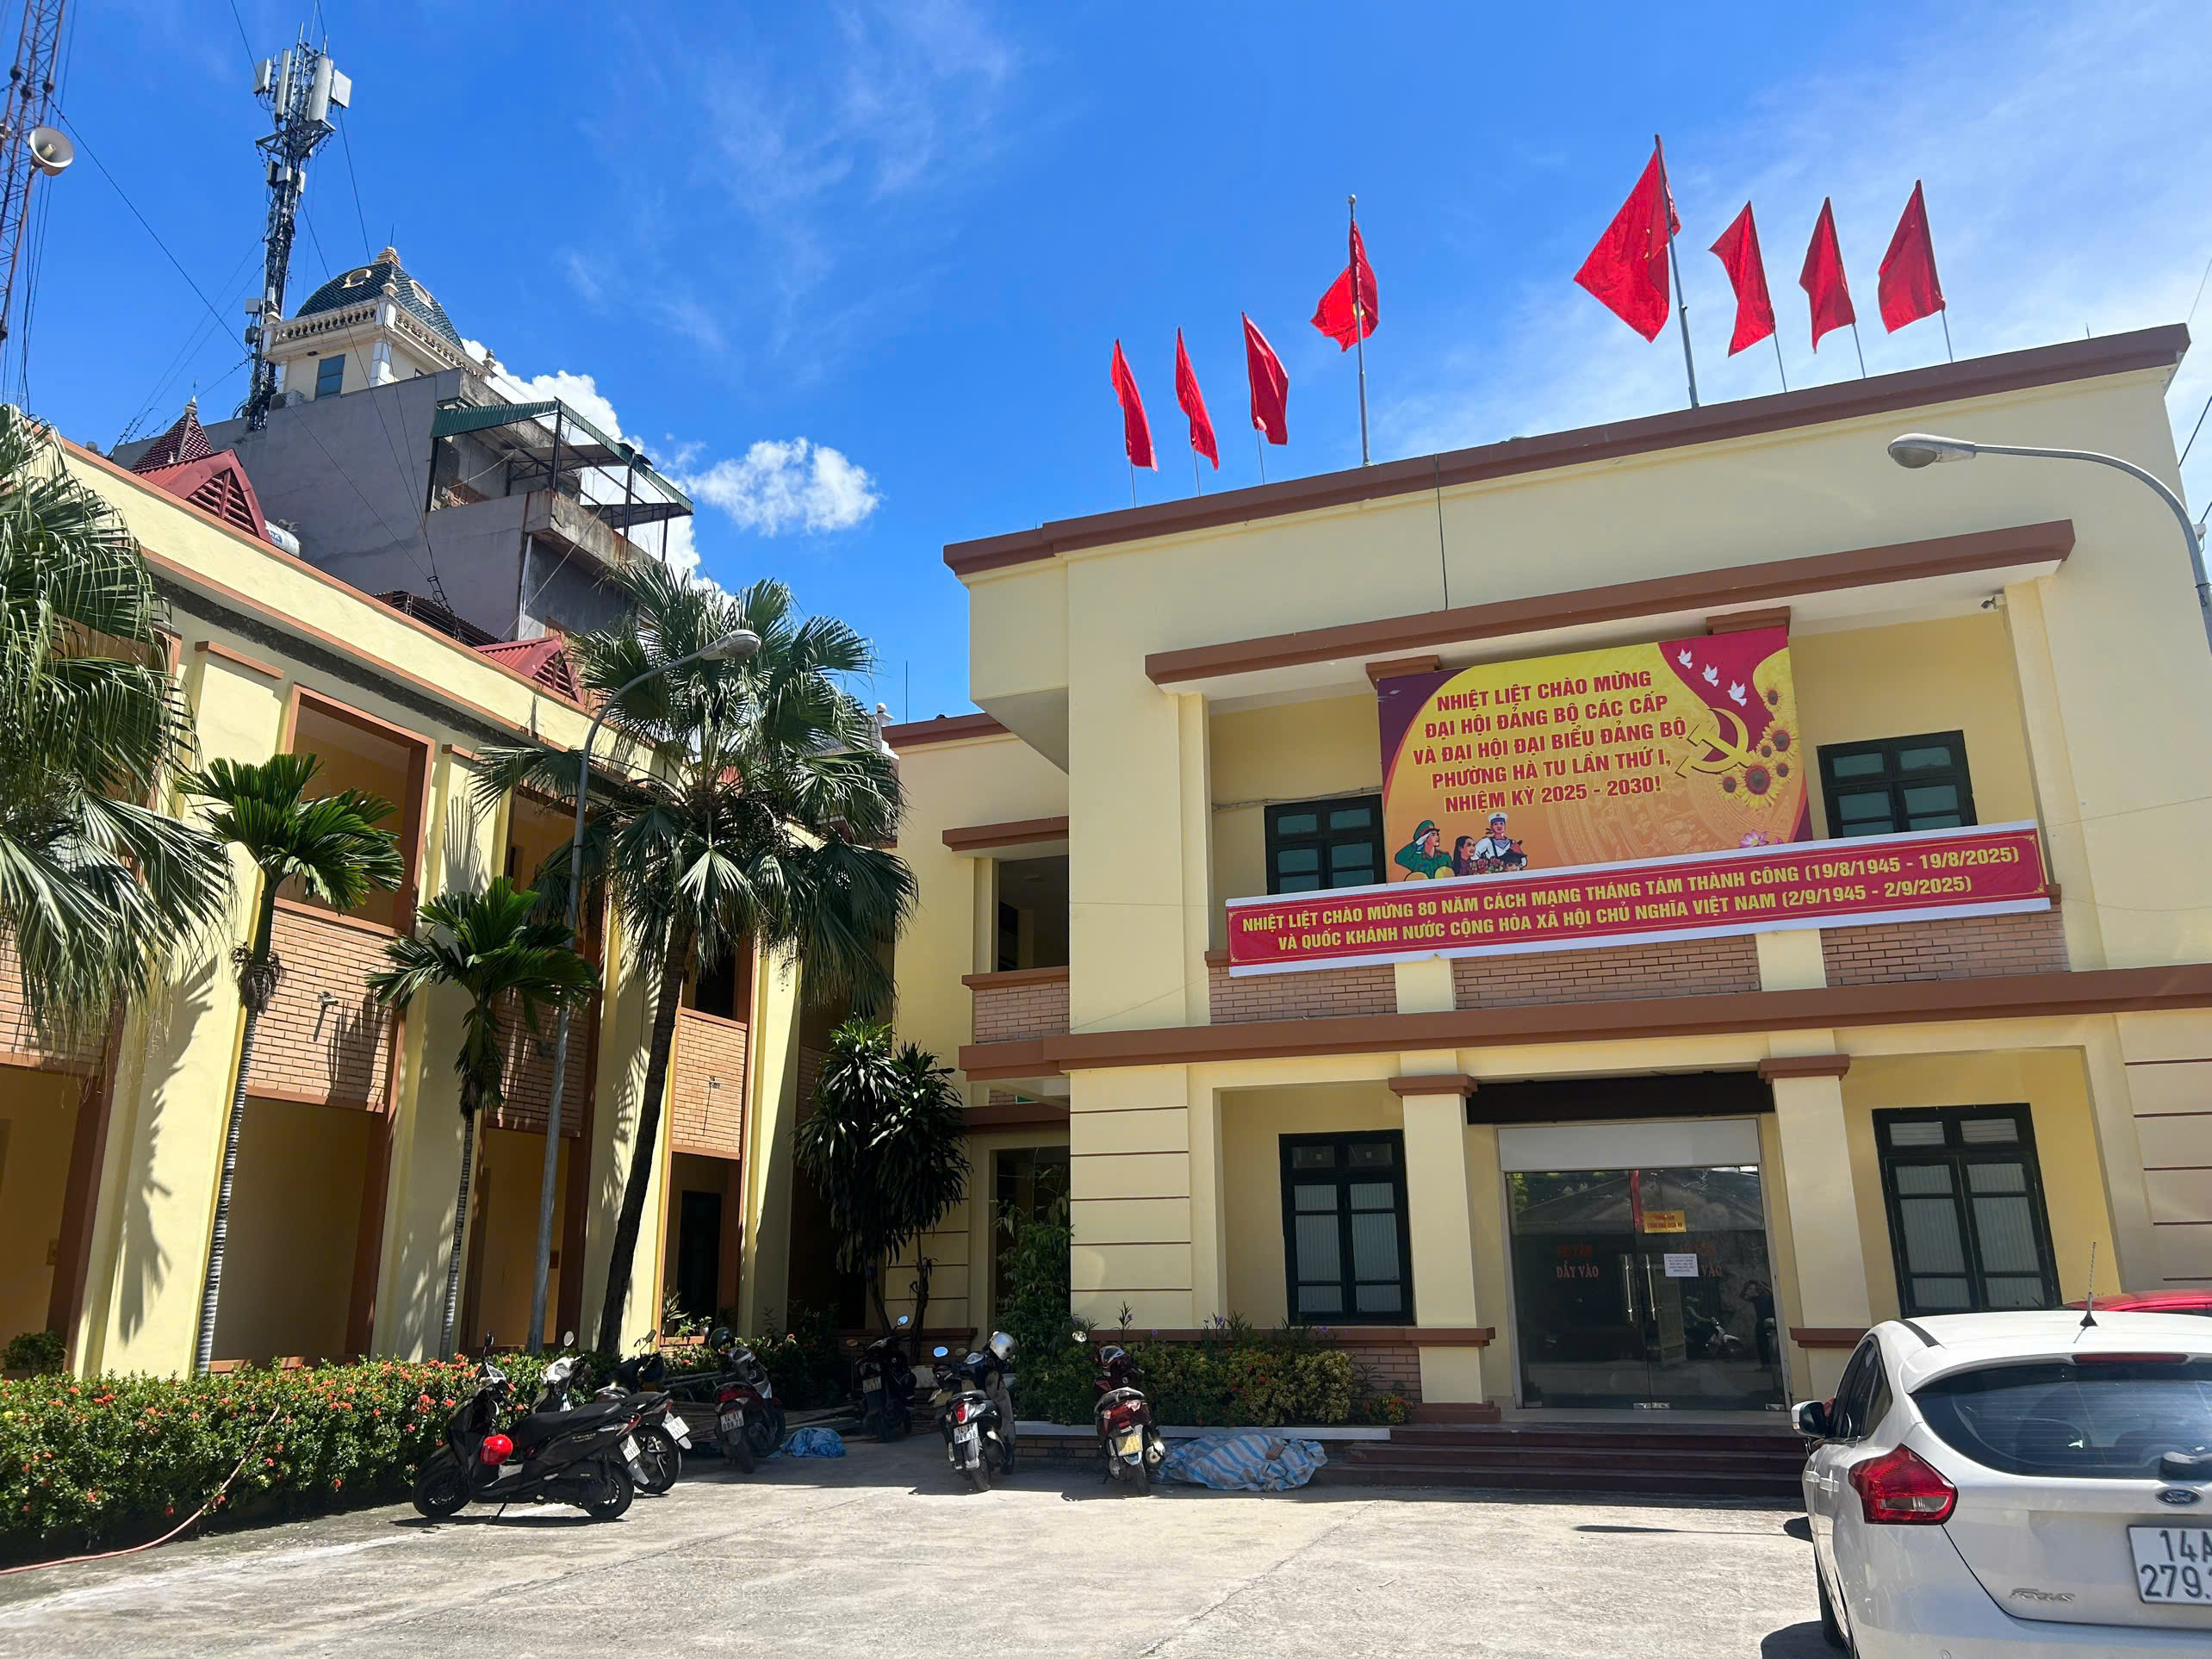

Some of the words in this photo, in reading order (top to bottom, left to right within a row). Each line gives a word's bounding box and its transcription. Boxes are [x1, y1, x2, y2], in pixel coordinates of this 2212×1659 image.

[1437, 689, 1488, 711] NHIỆT
[1494, 683, 1532, 705] LIỆT
[1538, 677, 1588, 699] CHÀO
[1594, 670, 1651, 693] MỪNG
[1425, 720, 1456, 740] ĐẠI
[1460, 714, 1491, 736] HỘI
[1496, 705, 1548, 730] ĐẢNG
[1554, 702, 1579, 724] BỘ
[1584, 699, 1623, 719] CÁC
[1629, 691, 1668, 715] CẤP
[1413, 745, 1437, 765] VÀ
[1441, 744, 1472, 764] ĐẠI
[1477, 737, 1508, 760] HỘI
[1513, 736, 1546, 756] ĐẠI
[1551, 724, 1594, 749] BIỂU
[1600, 719, 1655, 744] ĐẢNG
[1660, 716, 1686, 739] BỘ
[1432, 765, 1507, 789] PHƯỜNG
[1512, 760, 1538, 780] HÀ
[1543, 759, 1566, 777] TU
[1572, 750, 1610, 774] LẦN
[1615, 745, 1654, 769] THỨ
[1657, 749, 1672, 767] I,
[1445, 790, 1506, 813] NHIỆM
[1511, 785, 1534, 806] KỲ
[1541, 783, 1588, 804] 2025
[1607, 775, 1661, 797] 2030!
[1242, 915, 1284, 932] NHIỆT
[1288, 912, 1317, 929] LIỆT
[1322, 907, 1363, 925] CHÀO
[1367, 904, 1414, 921] MỪNG
[1418, 902, 1437, 916] 80
[1441, 896, 1479, 915] NĂM
[1483, 893, 1527, 910] CÁCH
[1531, 888, 1581, 906] MẠNG
[1586, 882, 1641, 901] THÁNG
[1646, 878, 1682, 896] TÁM
[1687, 872, 1745, 892] THÀNH
[1749, 866, 1799, 885] CÔNG
[1805, 857, 1901, 882] (19/8/1945
[1919, 848, 2019, 869] 19/8/2025)
[1278, 933, 1297, 951] VÀ
[1302, 929, 1342, 948] QUỐC
[1345, 926, 1398, 945] KHÁNH
[1402, 923, 1445, 941] NƯỚC
[1450, 919, 1494, 938] CỘNG
[1498, 914, 1532, 931] HÒA
[1536, 911, 1558, 929] XÃ
[1563, 909, 1591, 929] HỘI
[1596, 903, 1630, 924] CHỦ
[1635, 900, 1688, 921] NGHĨA
[1693, 896, 1729, 917] VIỆT
[1734, 893, 1776, 910] NAM
[1781, 885, 1867, 909] (2/9/1945
[1884, 877, 1972, 898] 2/9/2025)
[2141, 1563, 2212, 1599] 279.
